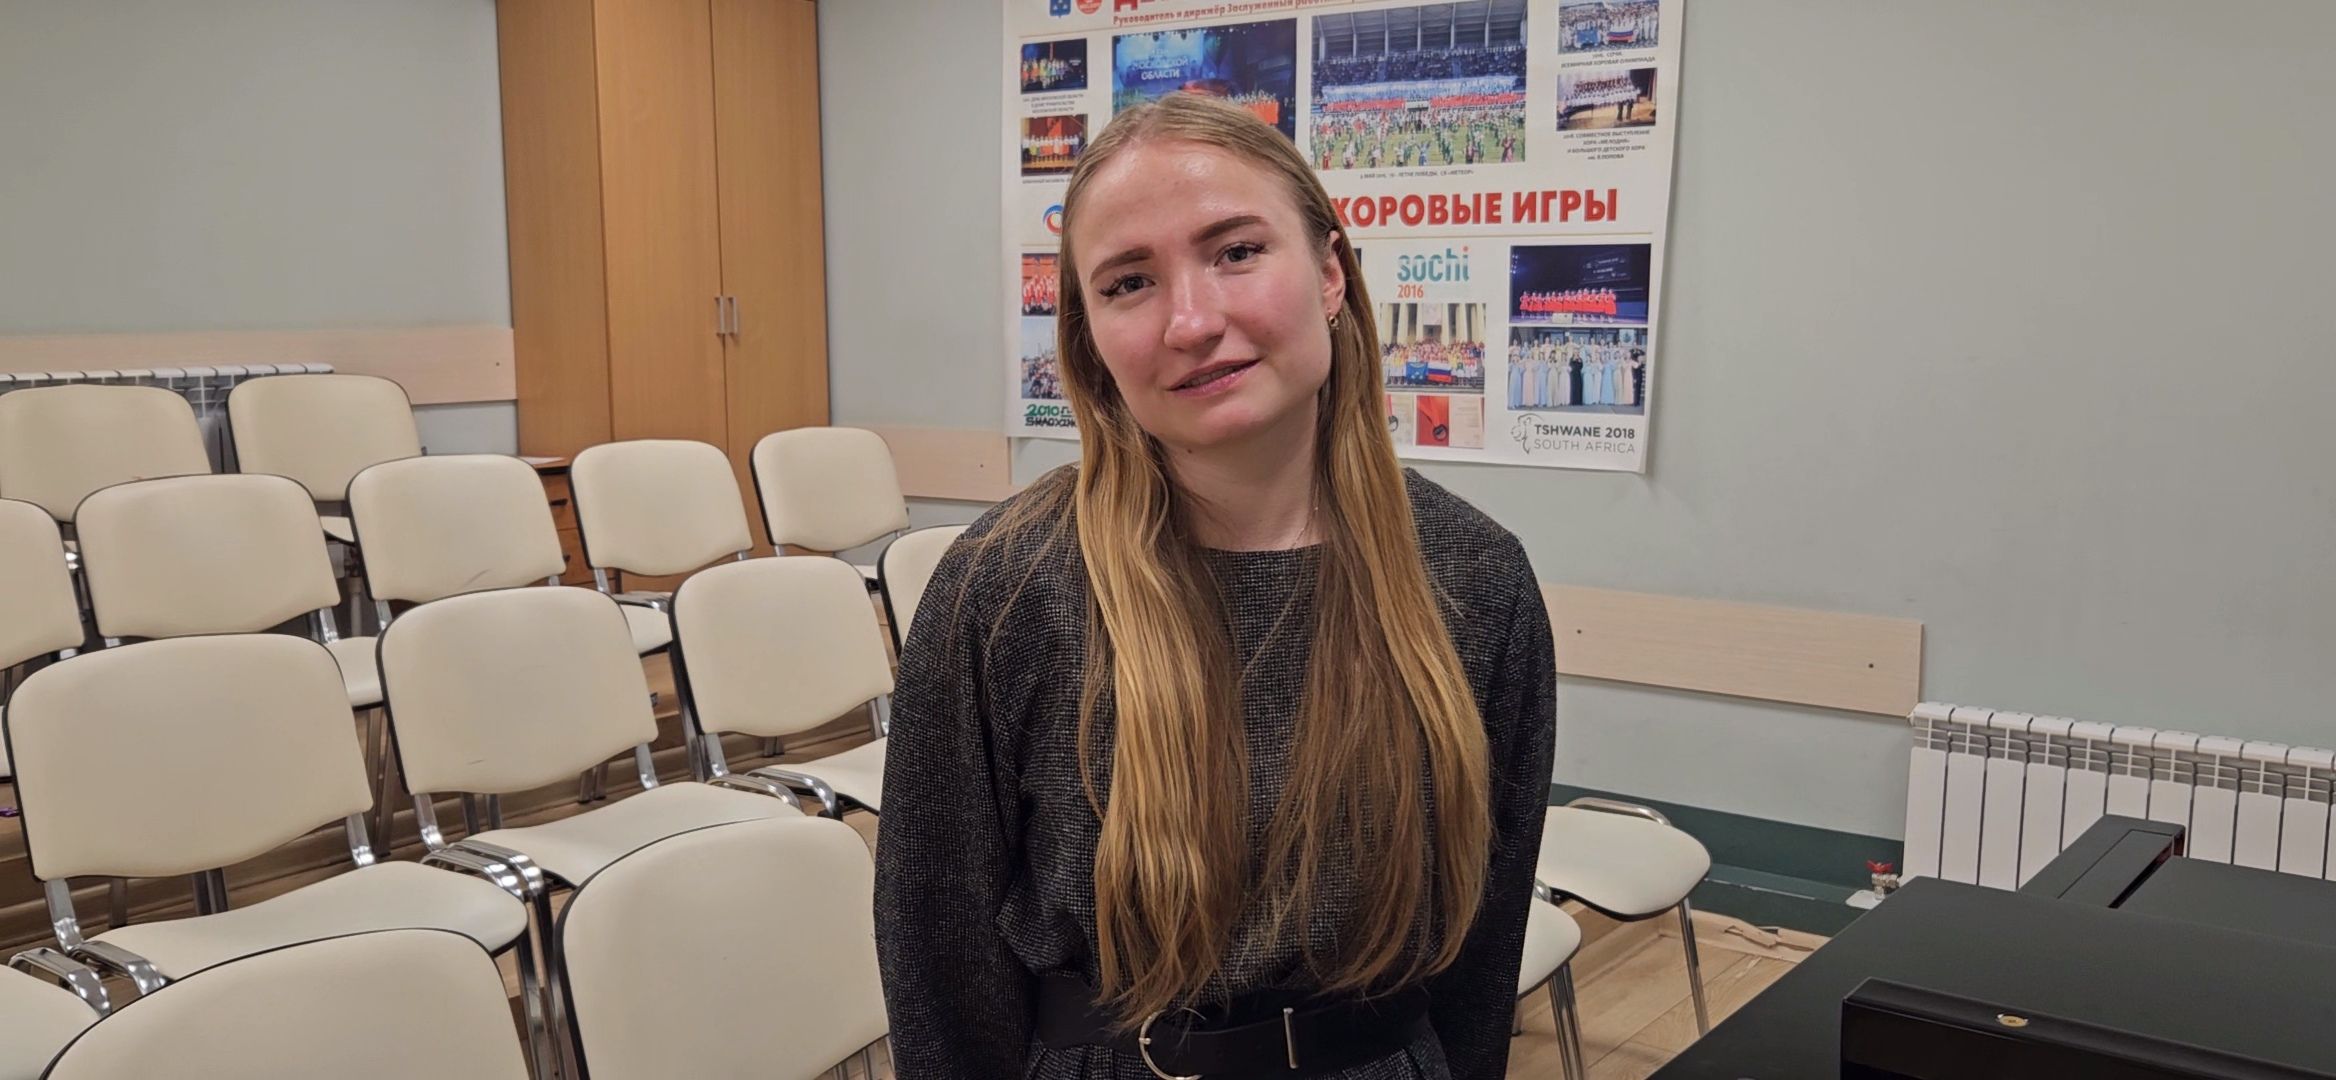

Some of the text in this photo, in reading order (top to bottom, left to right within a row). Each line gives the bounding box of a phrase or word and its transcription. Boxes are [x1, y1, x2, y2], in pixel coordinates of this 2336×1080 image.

[1113, 13, 1175, 27] Руководитель
[1183, 5, 1226, 20] дирижёр
[1141, 68, 1180, 80] ОБЛАСТИ
[1331, 188, 1617, 227] ХОРОВЫЕ ИГРЫ
[1397, 246, 1470, 282] sochi
[1397, 284, 1424, 299] 2016
[1024, 403, 1060, 417] 2010
[1534, 424, 1636, 440] TSHWANE 2018
[1534, 438, 1635, 454] SOUTH AFRICA
